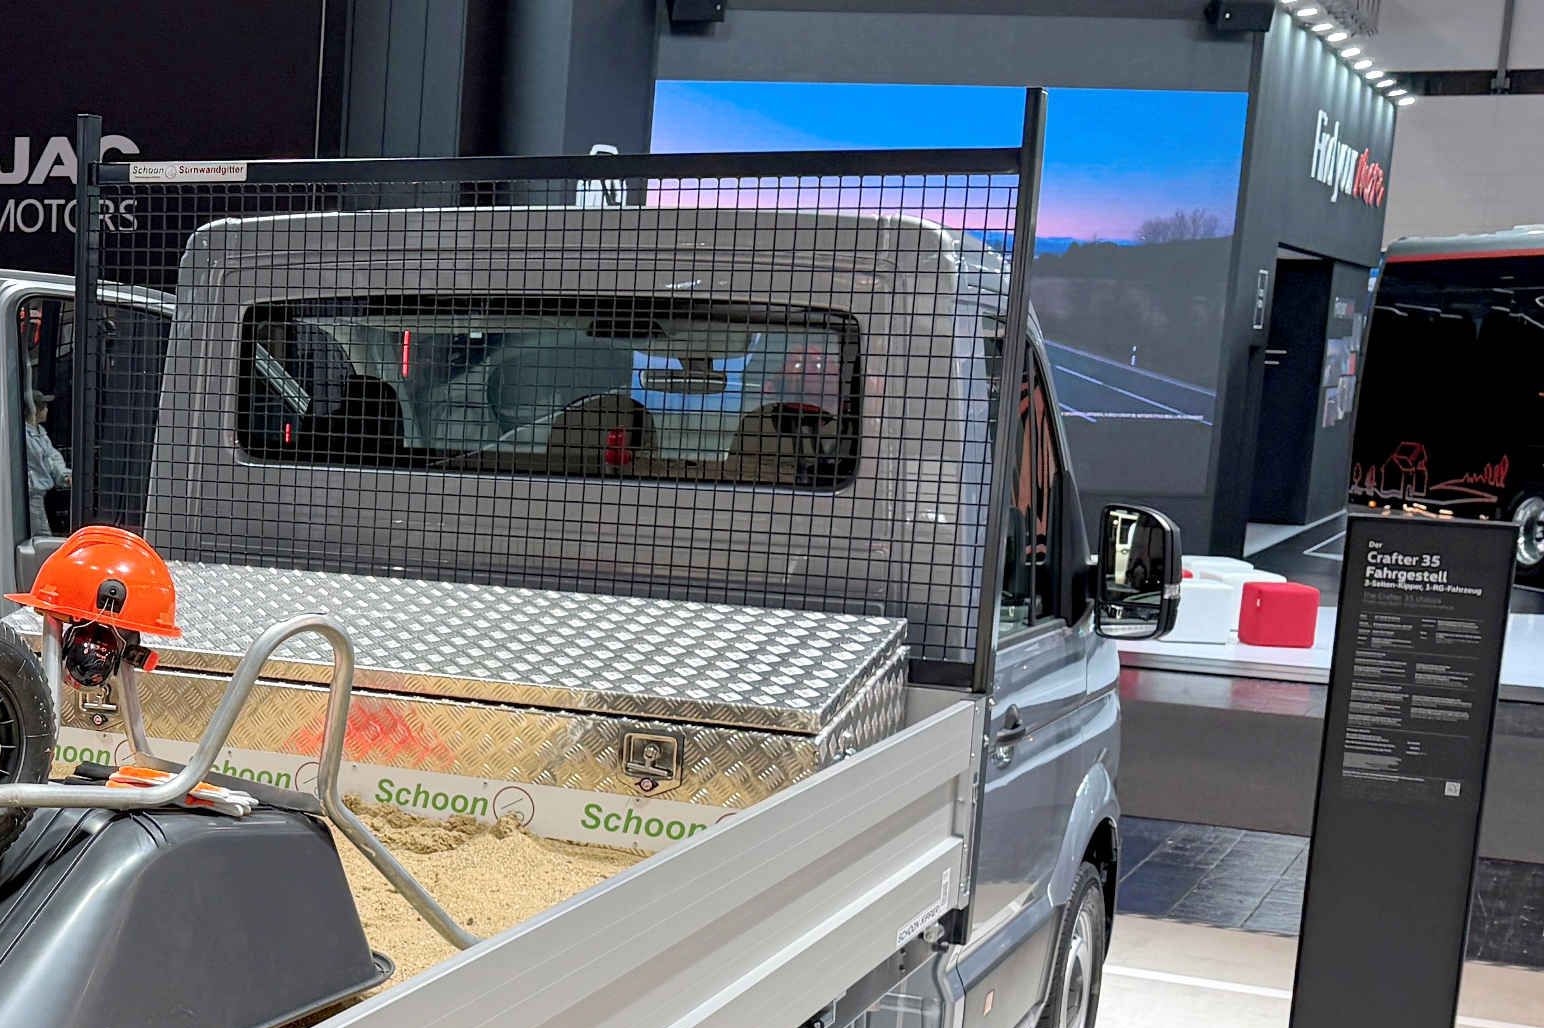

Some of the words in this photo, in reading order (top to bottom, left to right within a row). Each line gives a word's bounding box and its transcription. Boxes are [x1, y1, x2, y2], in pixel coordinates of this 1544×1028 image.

[133, 165, 164, 175] Schoon
[1368, 541, 1383, 549] Der
[1367, 550, 1419, 566] Crafter
[1421, 554, 1441, 567] 35
[1365, 566, 1448, 583] Fahrgestell
[375, 778, 488, 817] Schoon
[580, 803, 707, 841] Schoon
